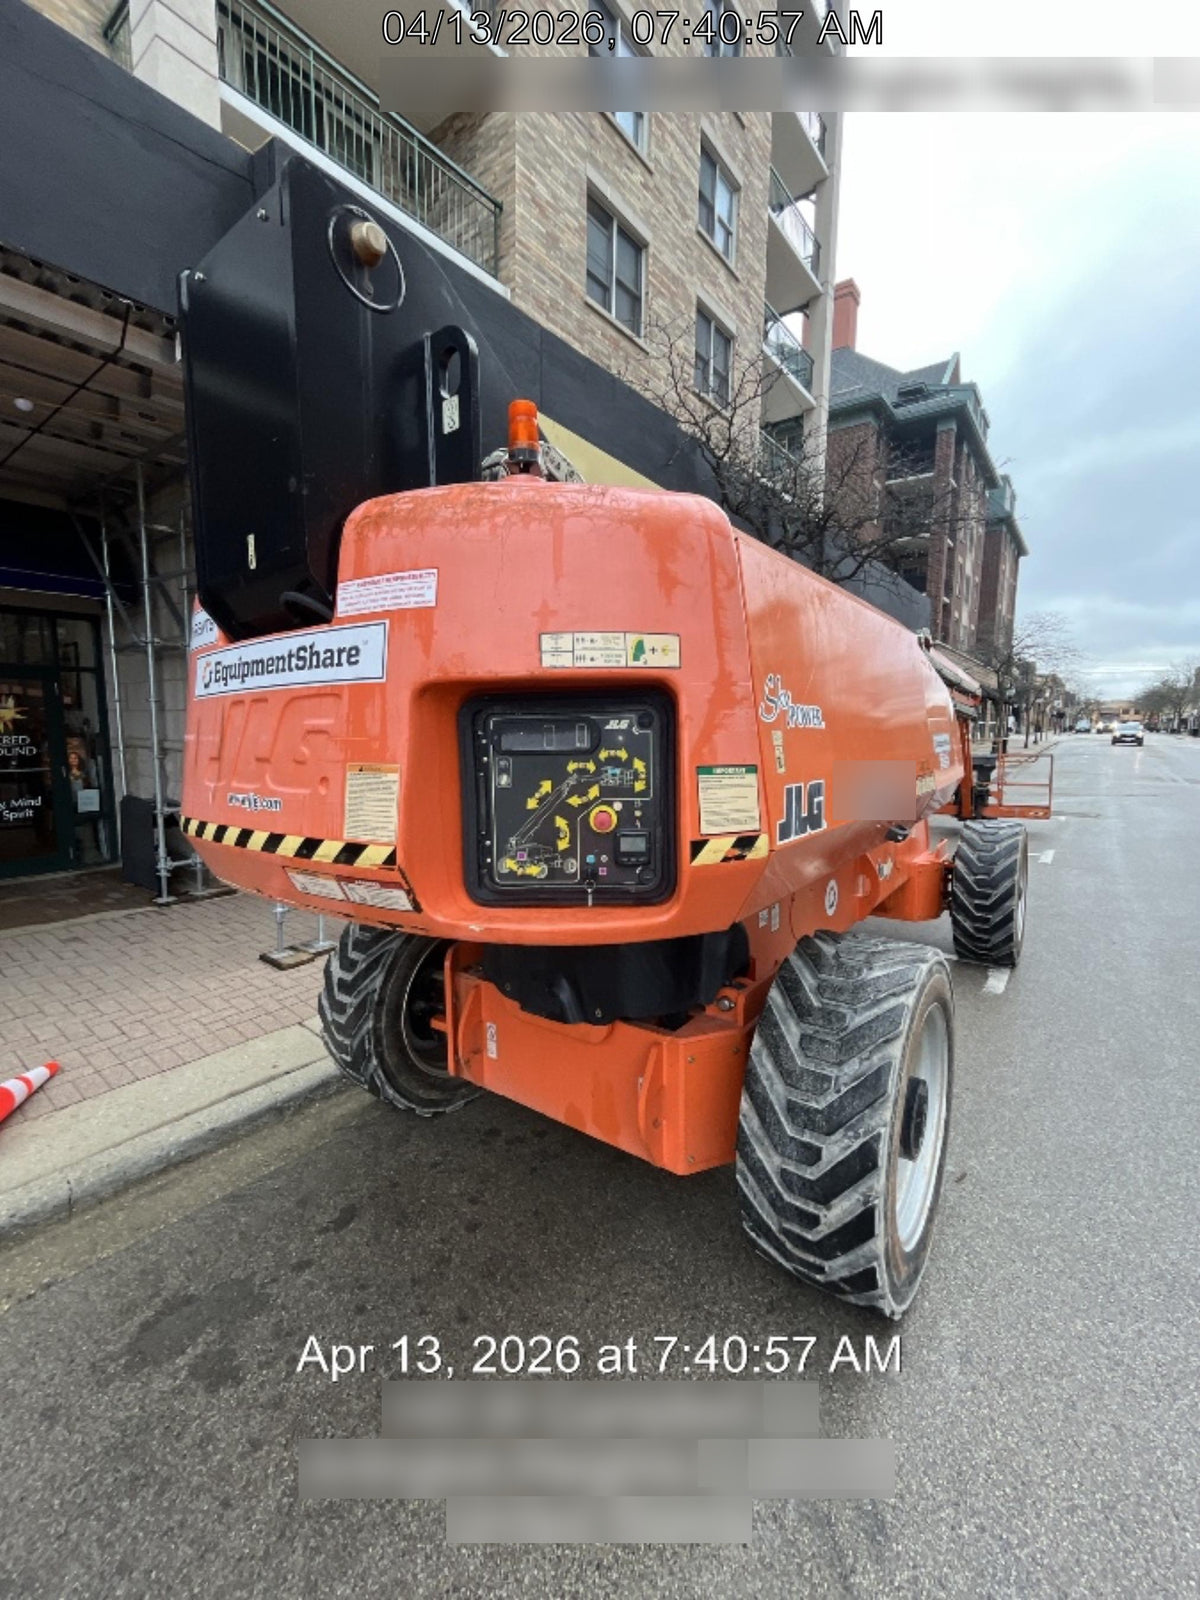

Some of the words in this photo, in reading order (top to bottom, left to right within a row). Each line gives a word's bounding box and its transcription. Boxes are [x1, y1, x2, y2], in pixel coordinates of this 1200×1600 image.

[214, 641, 361, 687] EquipmentShare
[3, 808, 34, 821] Spirit
[10, 796, 42, 808] Mind
[777, 780, 827, 845] JLG
